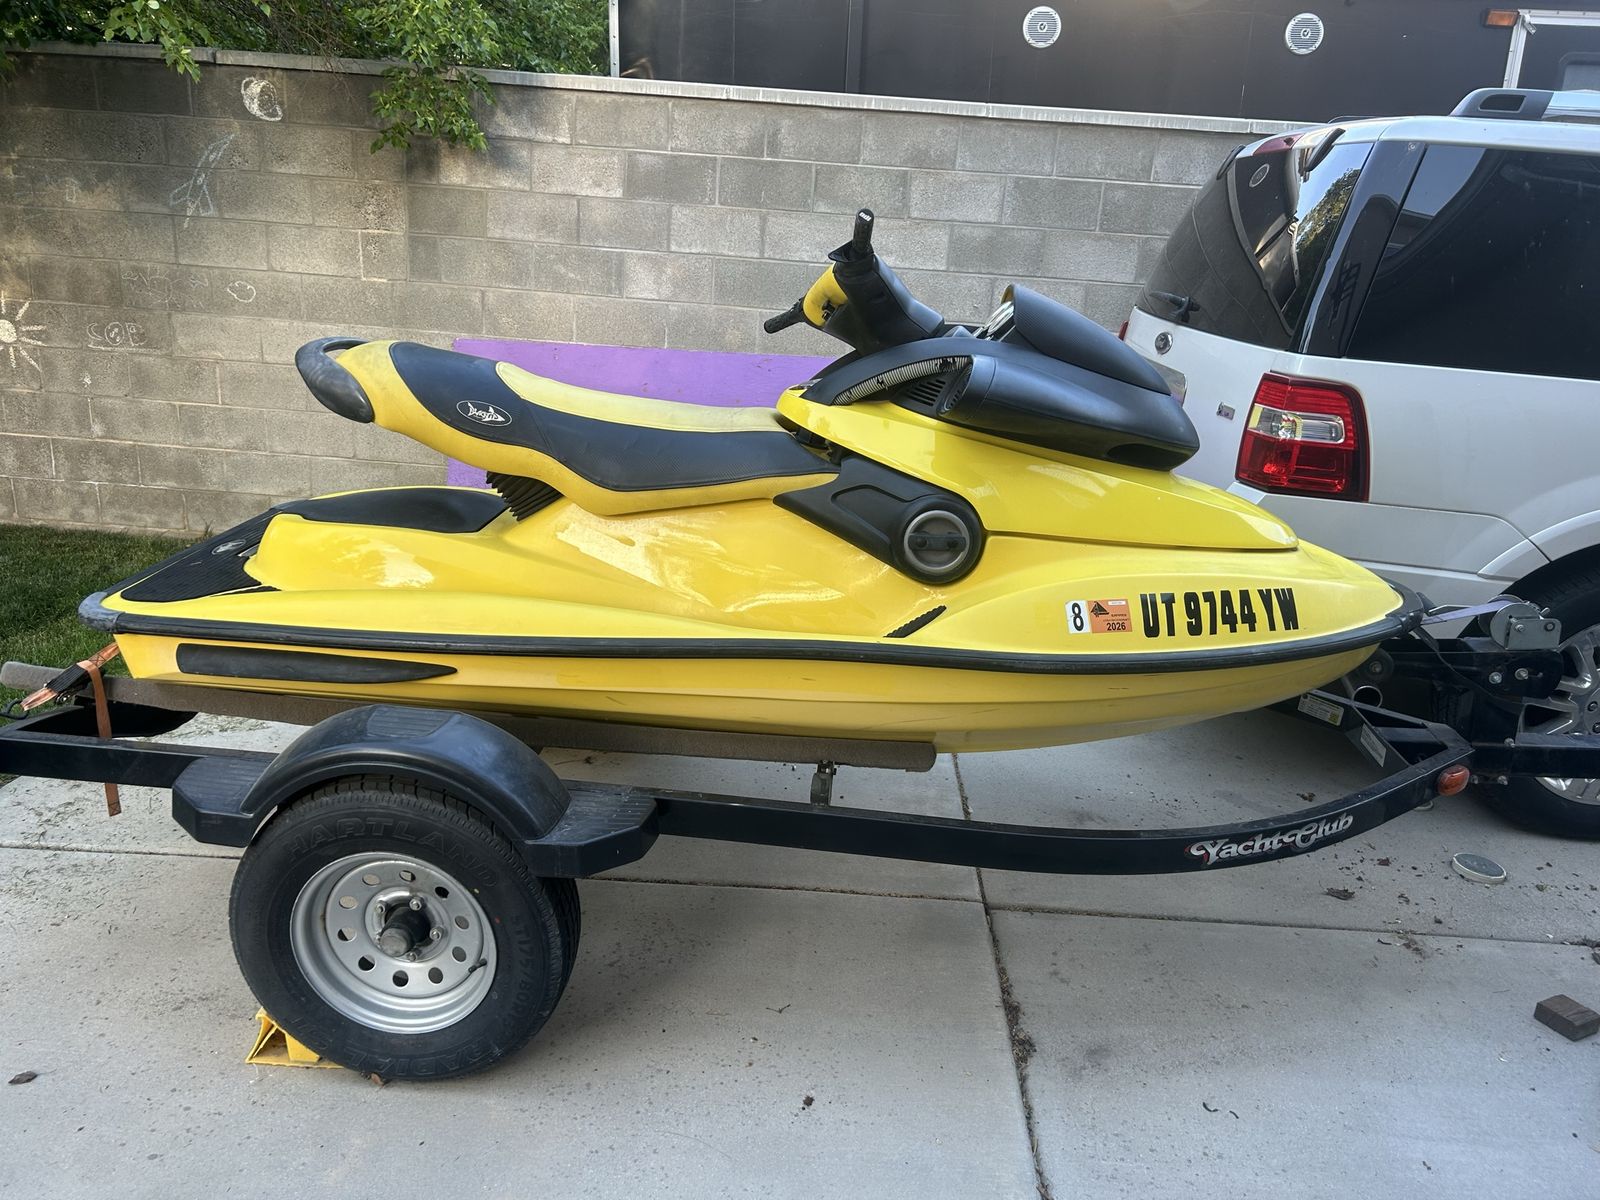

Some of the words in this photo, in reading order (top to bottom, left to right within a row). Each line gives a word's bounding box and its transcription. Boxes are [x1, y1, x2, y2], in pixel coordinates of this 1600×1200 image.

[1071, 602, 1084, 632] 8
[1106, 622, 1127, 631] 2026
[1140, 593, 1176, 638] UT
[1184, 590, 1257, 636] 9744
[1257, 588, 1299, 632] YW
[286, 817, 498, 887] HARTLAND
[1190, 832, 1284, 866] Yacht
[1282, 812, 1354, 849] Club
